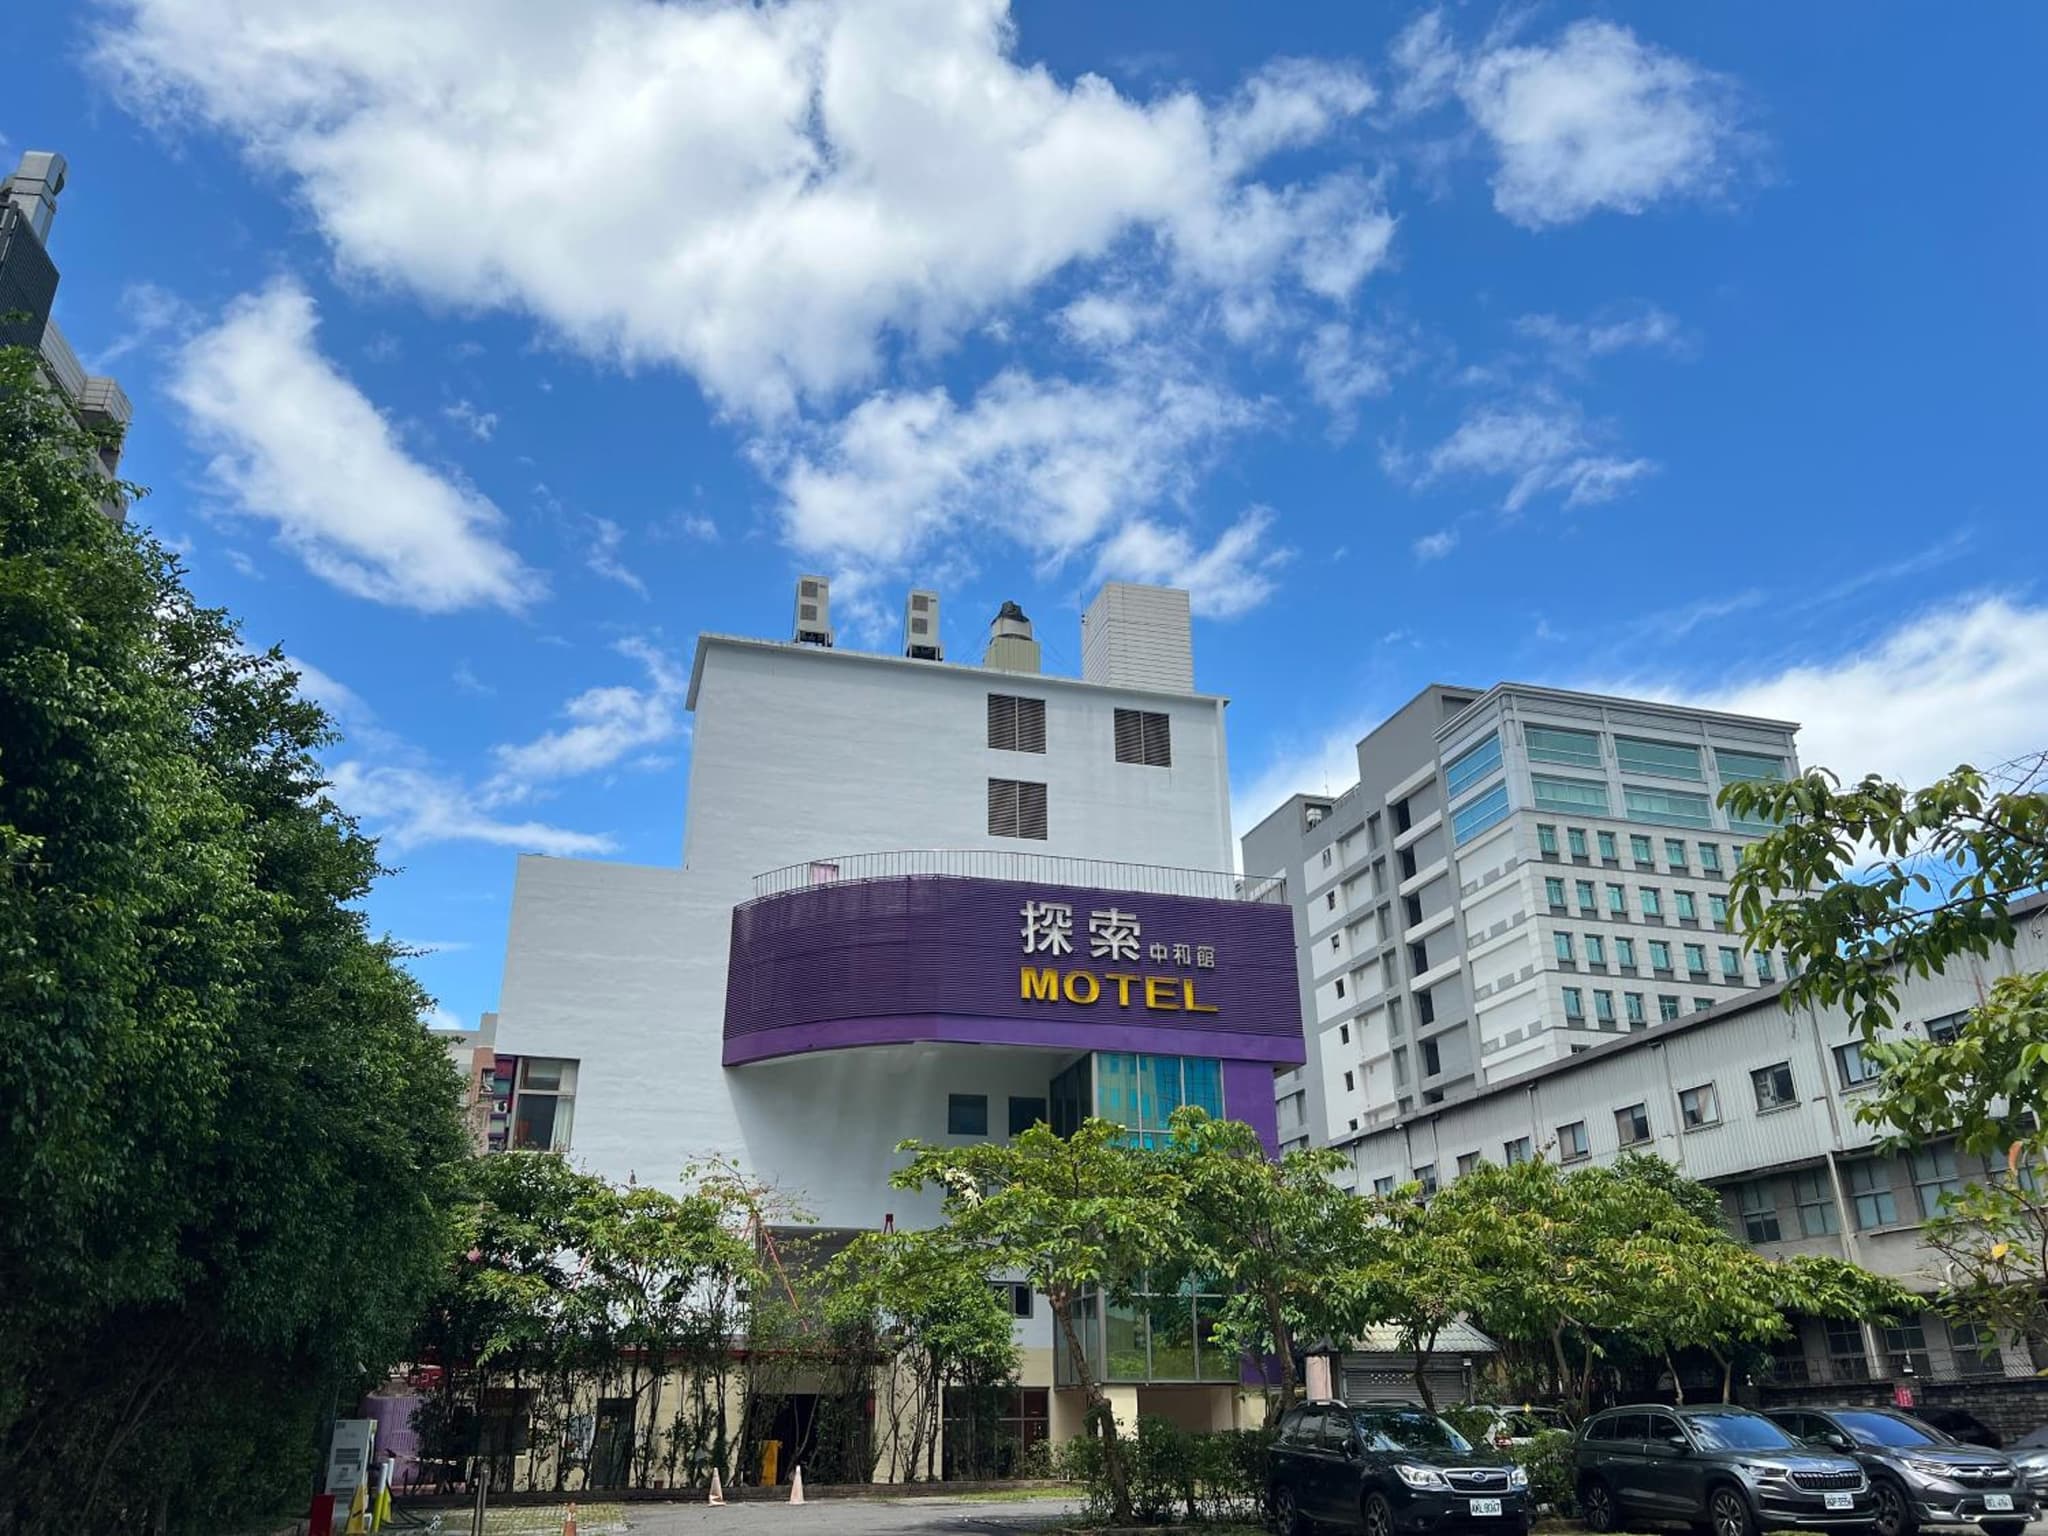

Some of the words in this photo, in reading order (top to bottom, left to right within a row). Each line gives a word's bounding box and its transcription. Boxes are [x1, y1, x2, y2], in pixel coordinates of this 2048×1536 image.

[1020, 901, 1141, 960] 探索
[1150, 943, 1215, 968] 中和館
[1020, 966, 1219, 1012] MOTEL
